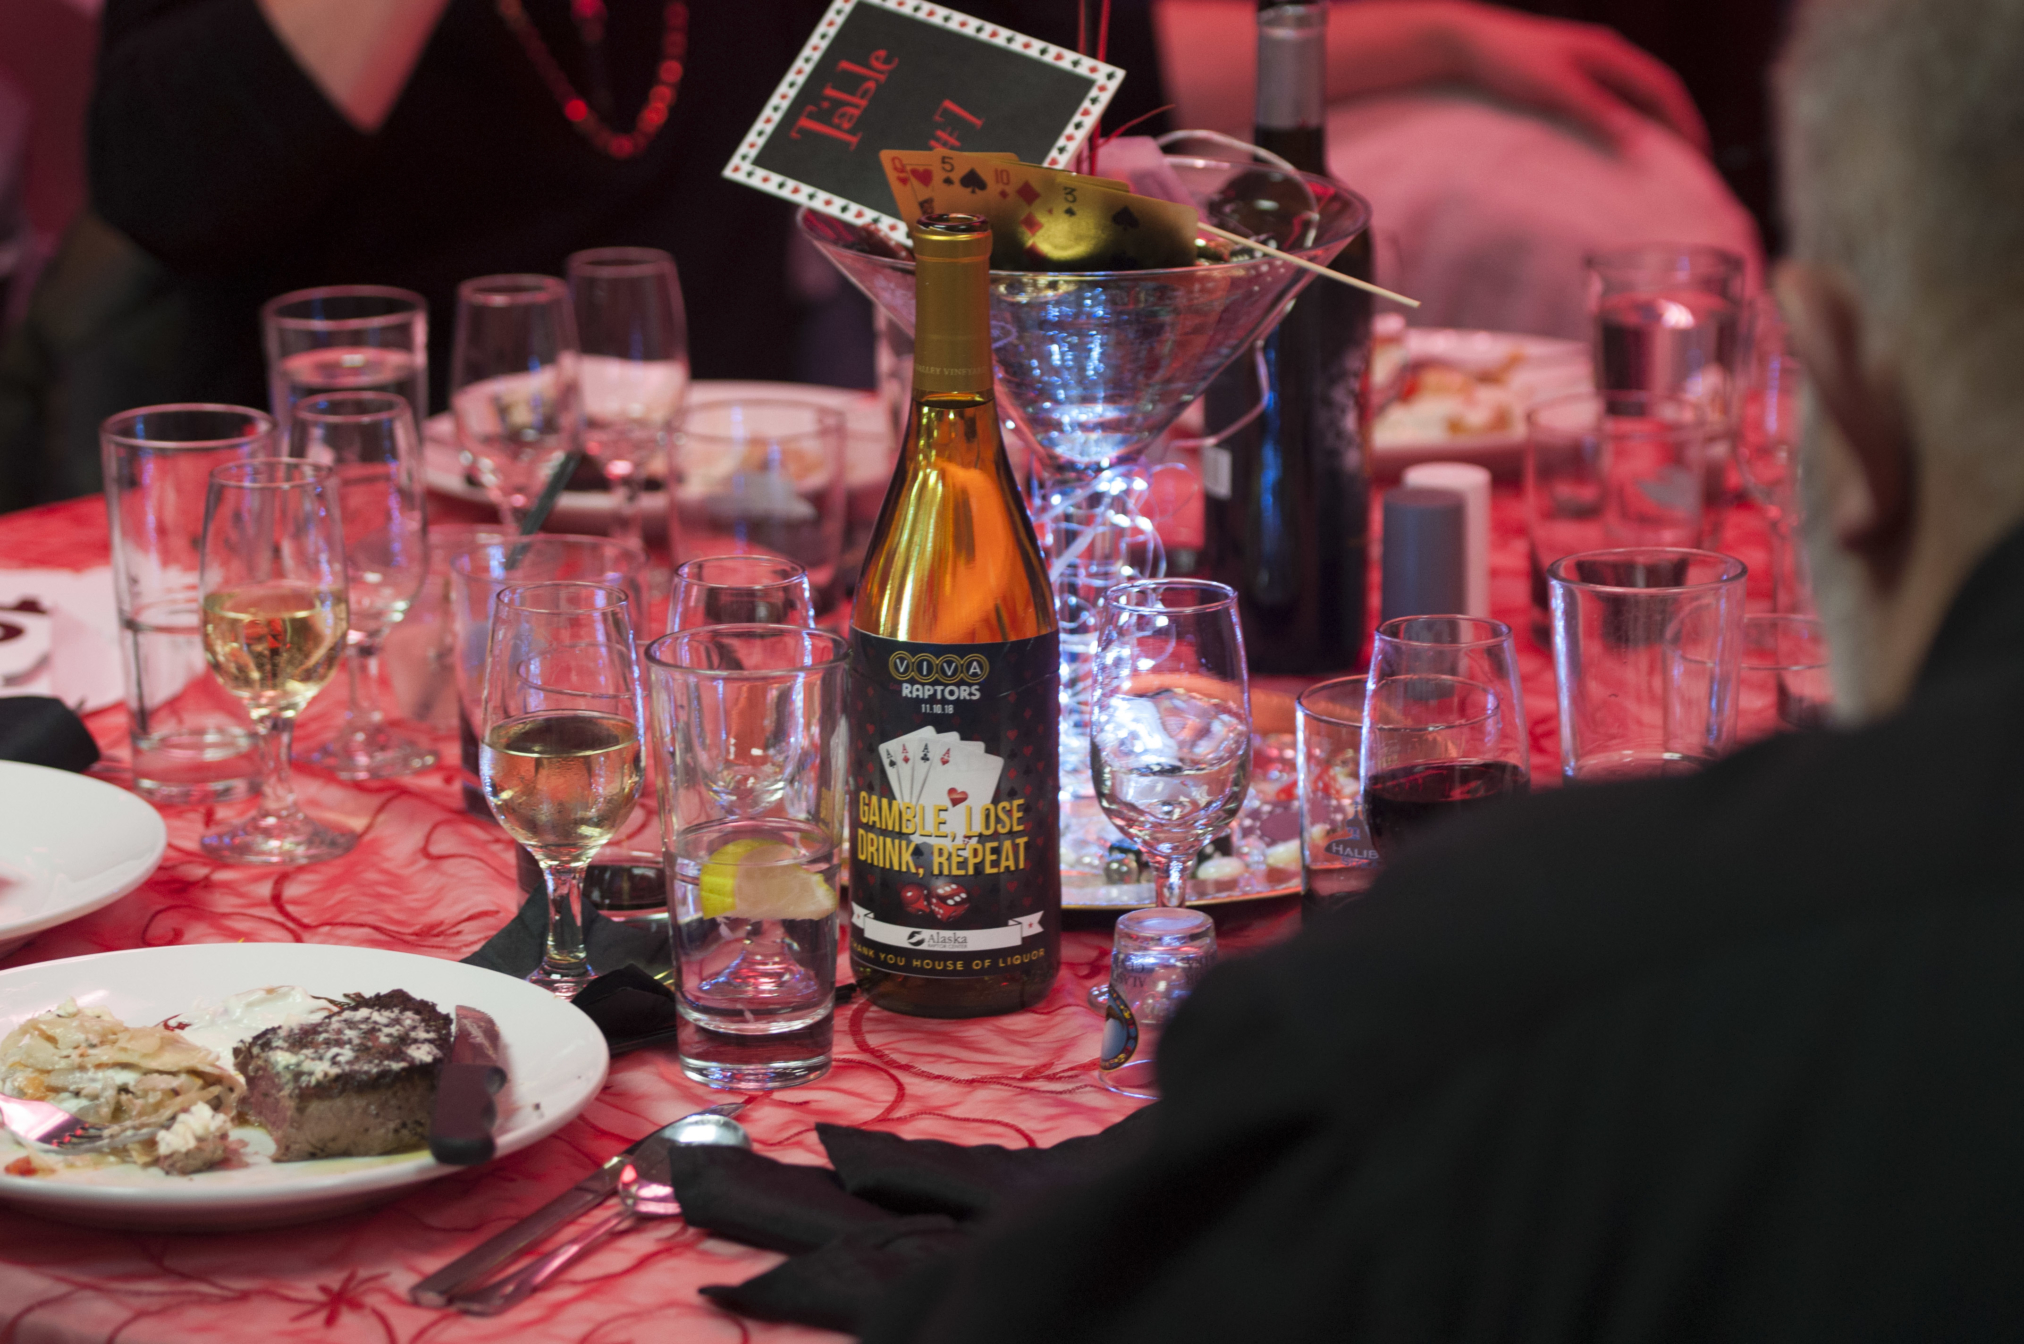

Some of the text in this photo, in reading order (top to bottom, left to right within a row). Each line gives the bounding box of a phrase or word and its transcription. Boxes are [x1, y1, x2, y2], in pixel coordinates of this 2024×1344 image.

[789, 48, 899, 151] Table
[927, 98, 986, 151] #7
[941, 155, 955, 173] 5
[994, 168, 1011, 186] 10
[1063, 186, 1078, 204] 3
[894, 658, 983, 677] VIVA
[901, 682, 982, 701] RAPTORS
[921, 703, 955, 714] 11.10.18
[859, 790, 1026, 842] GAMBLE, LOSE
[857, 827, 1029, 879] DRINK, REPEAT
[927, 931, 968, 944] Alaska
[879, 952, 906, 966] YOU
[912, 958, 965, 971] HOUSE
[972, 960, 992, 970] OF
[998, 948, 1046, 968] LIQUOR
